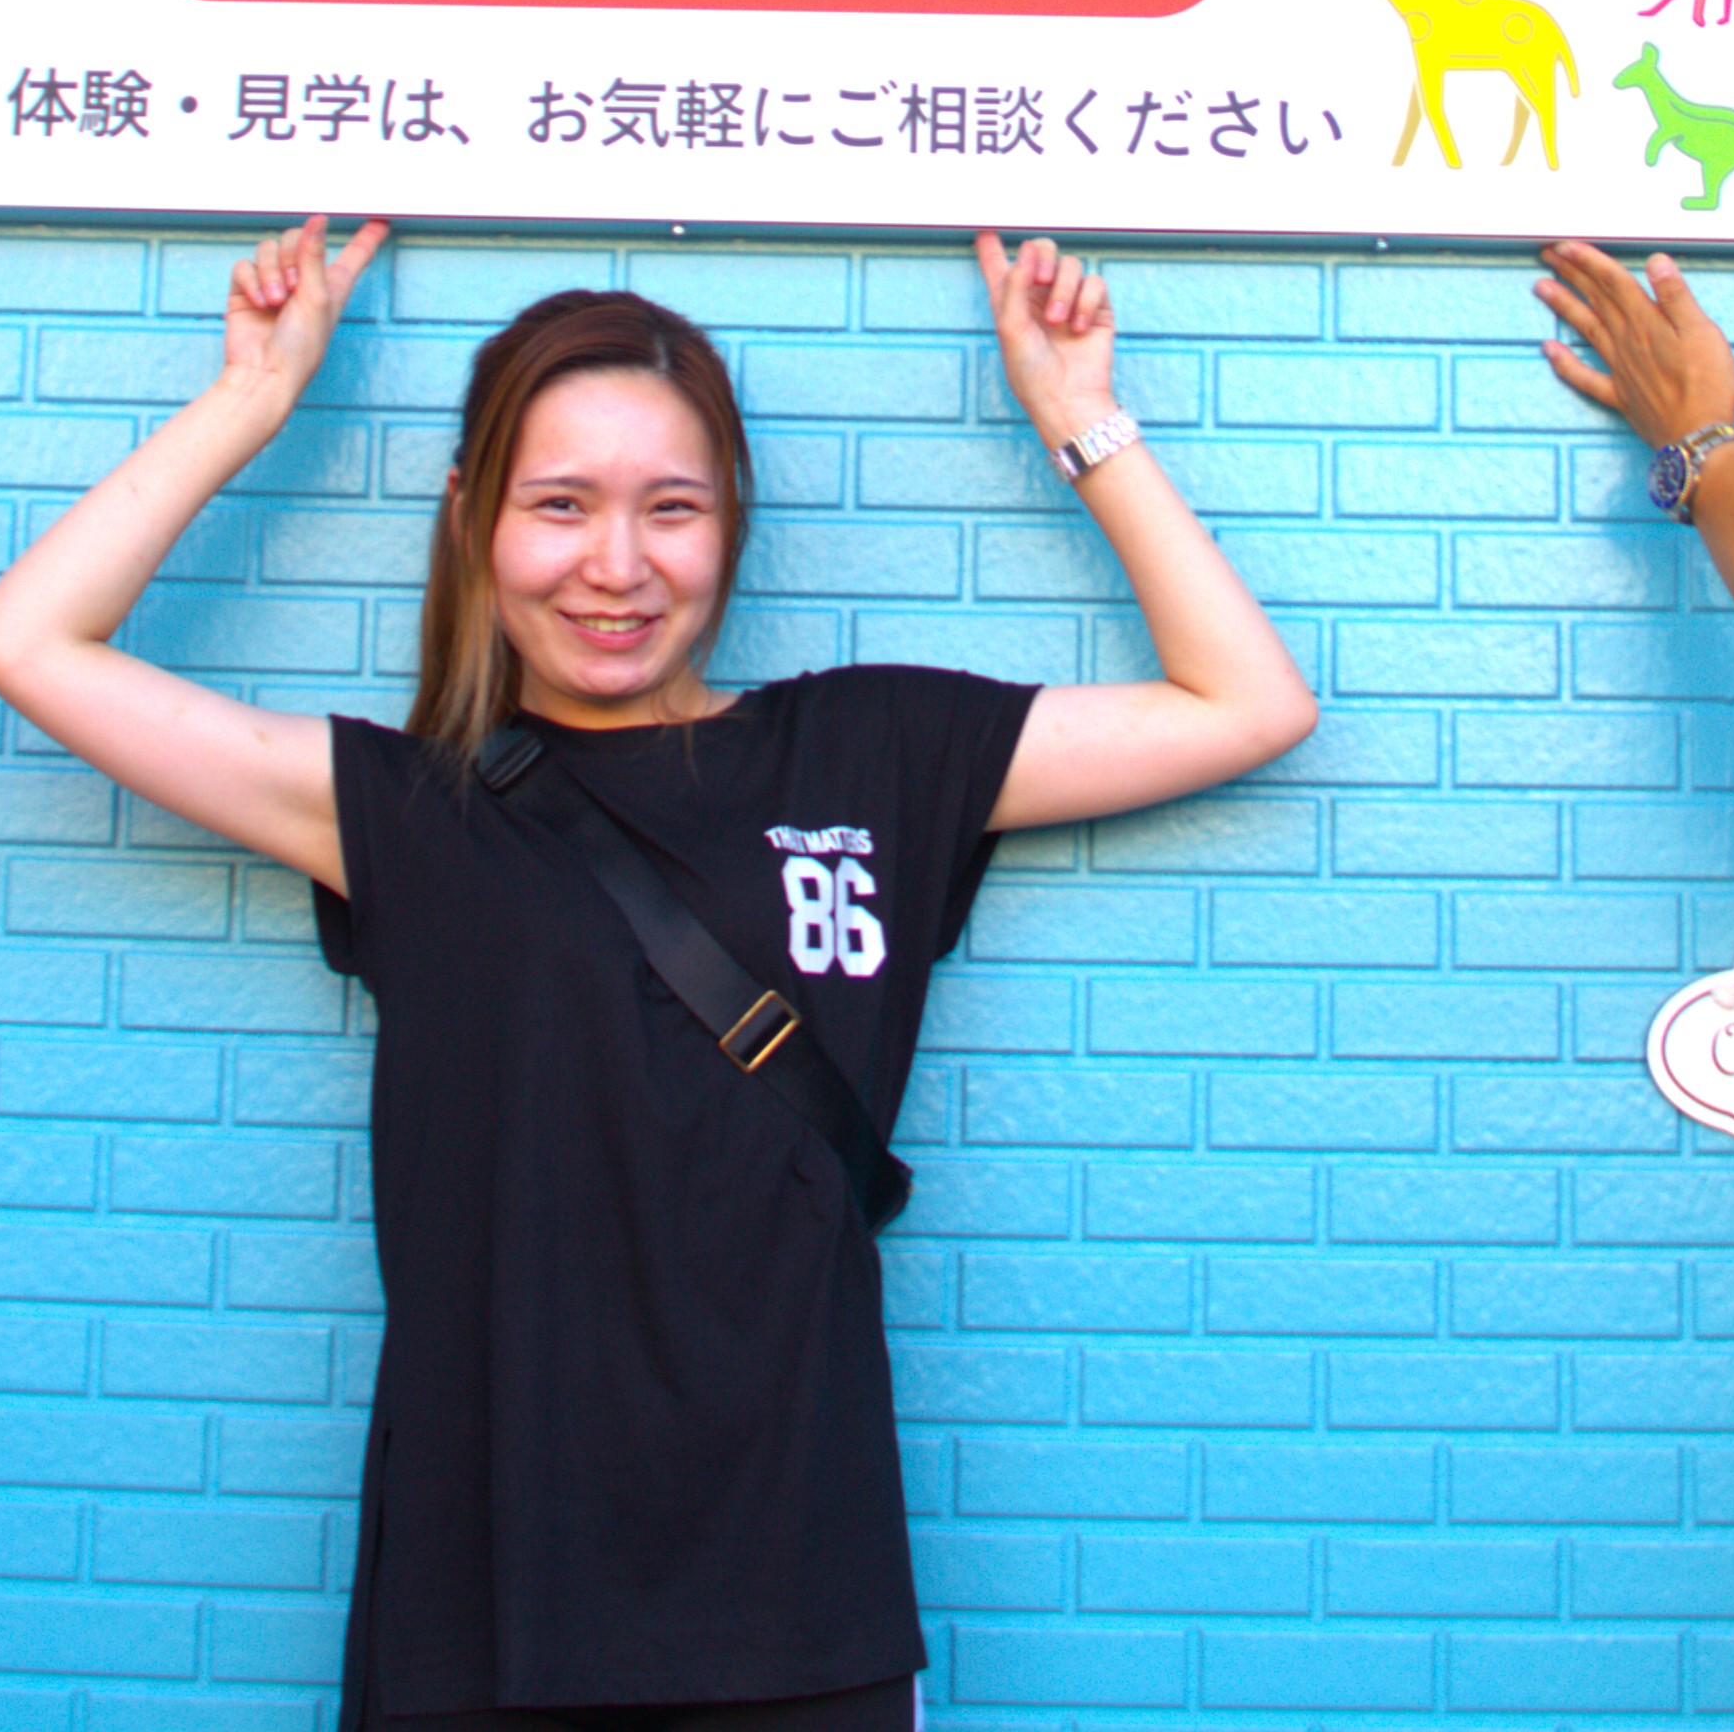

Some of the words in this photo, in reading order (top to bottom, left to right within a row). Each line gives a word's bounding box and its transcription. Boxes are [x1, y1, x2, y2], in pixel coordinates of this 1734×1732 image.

[6, 66, 1343, 159] 体験・見学は、お気軽にご相談ください
[781, 855, 887, 977] 86
